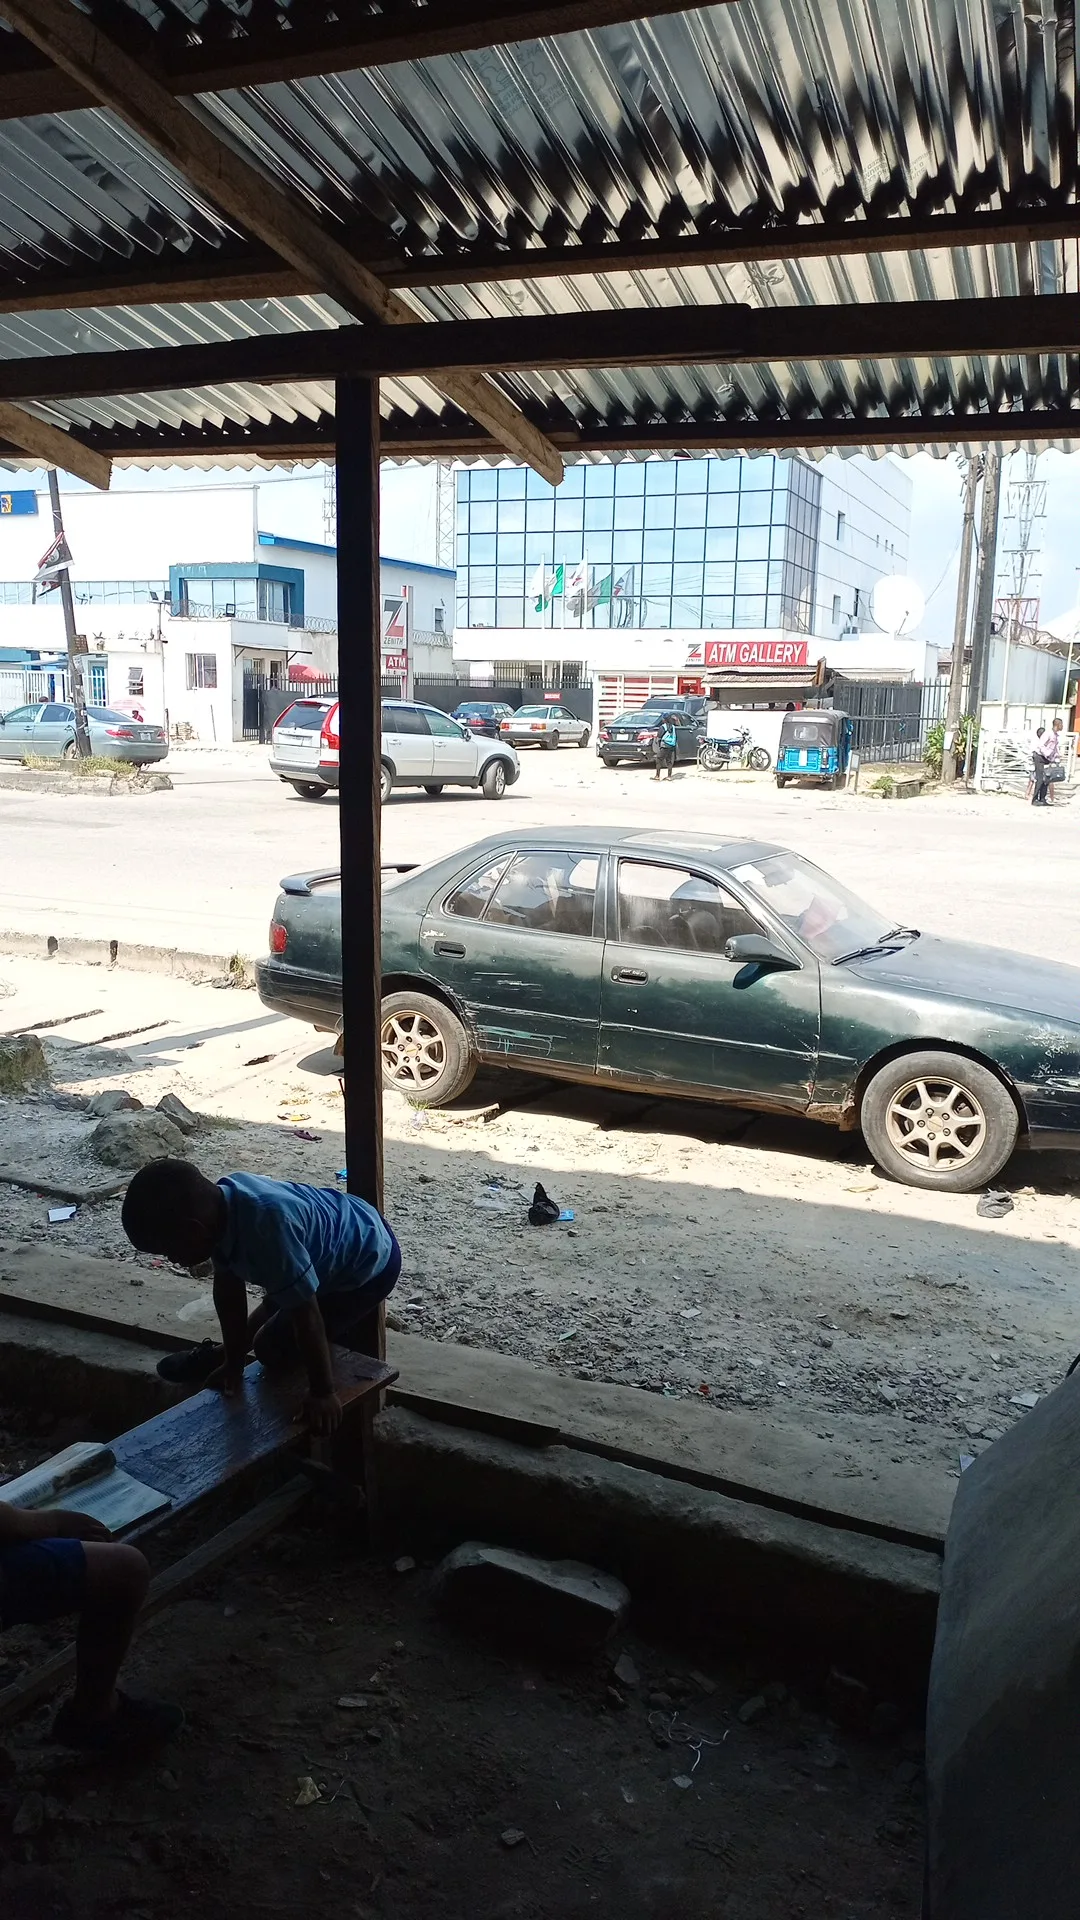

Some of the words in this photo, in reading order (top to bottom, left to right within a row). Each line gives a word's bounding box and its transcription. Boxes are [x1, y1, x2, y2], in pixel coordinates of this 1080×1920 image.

[709, 644, 737, 662] ATM
[740, 644, 803, 662] GALLERY
[387, 656, 406, 668] ATM
